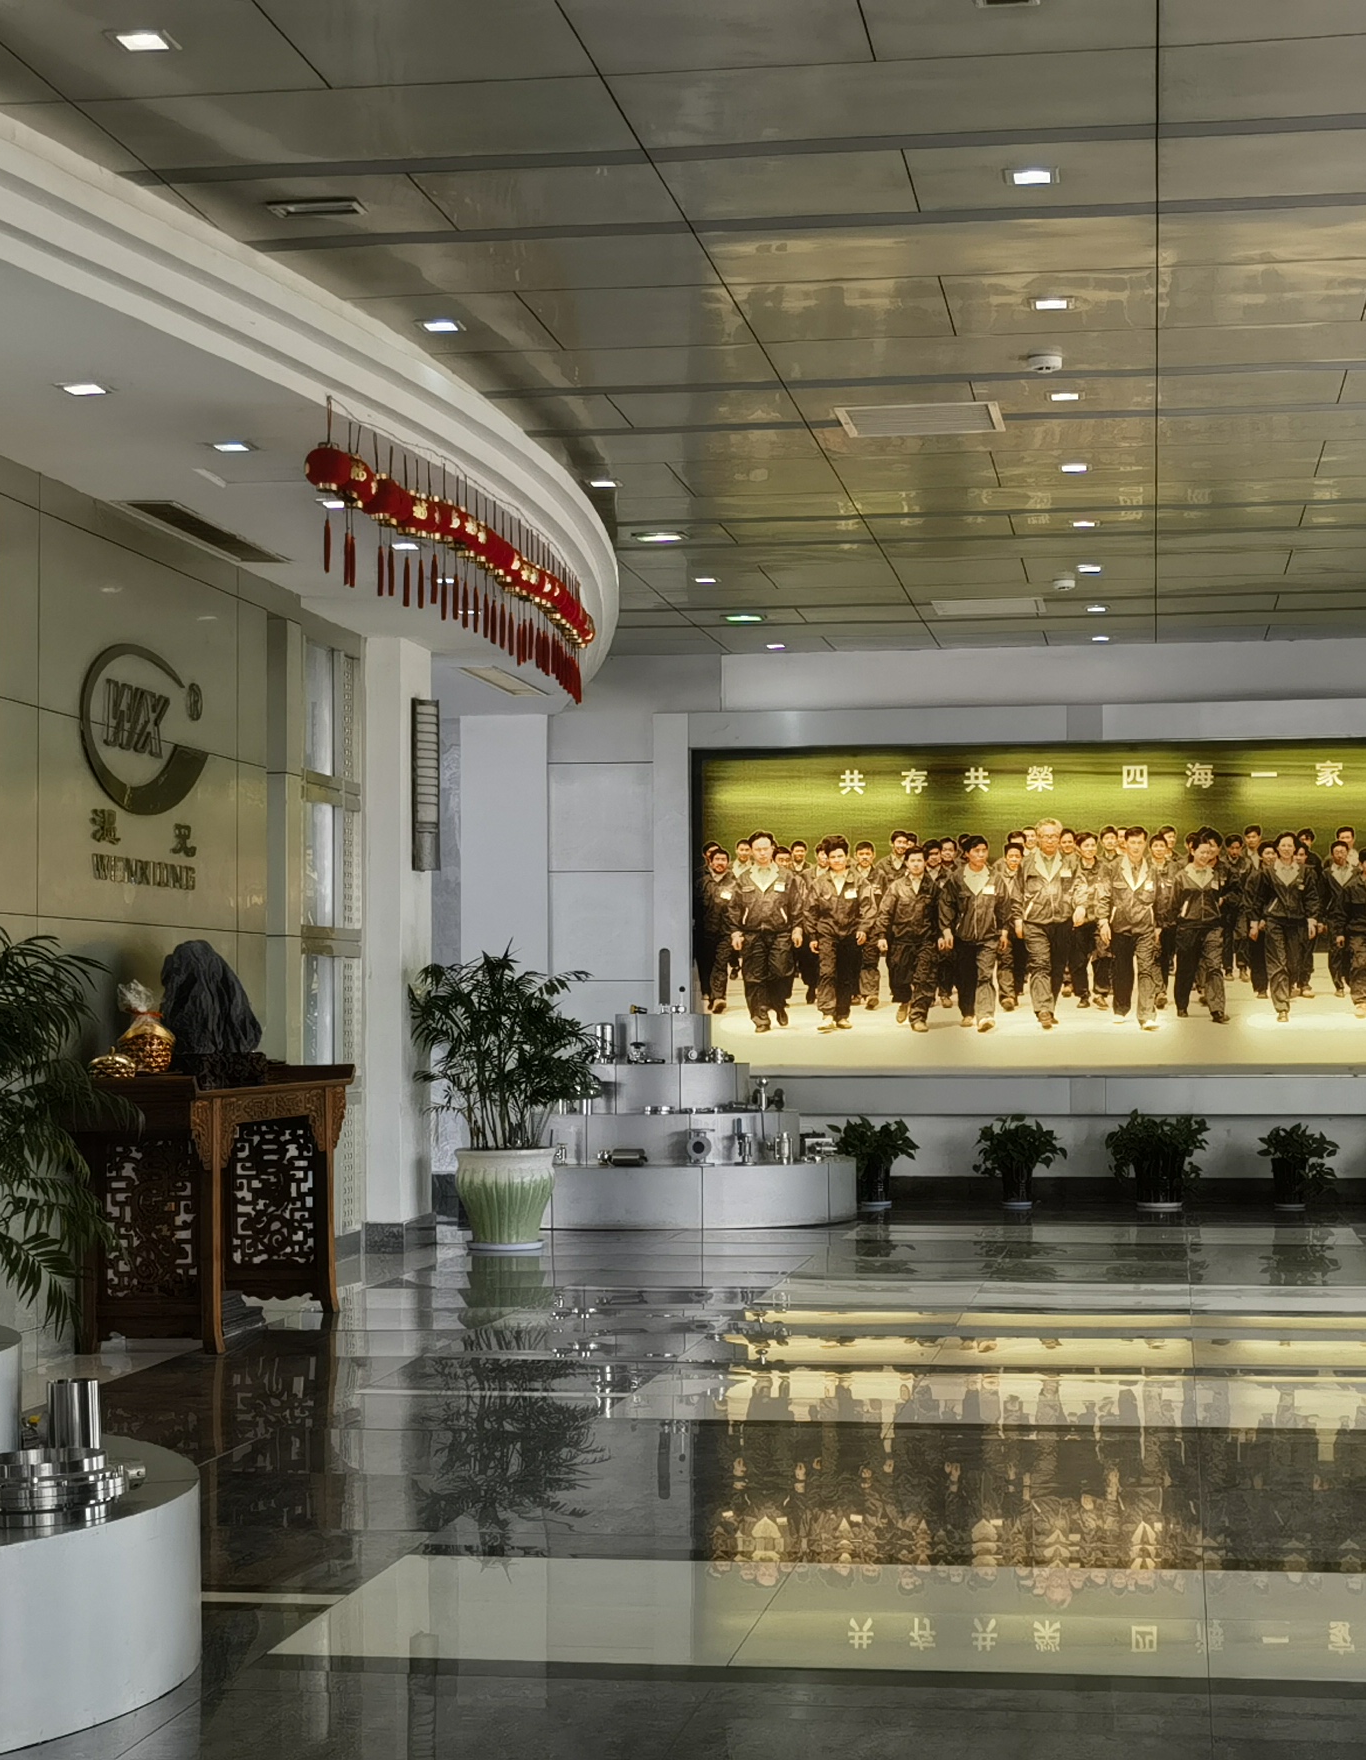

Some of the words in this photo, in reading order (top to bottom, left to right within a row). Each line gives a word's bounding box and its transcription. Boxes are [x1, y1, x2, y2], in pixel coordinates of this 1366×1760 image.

[103, 678, 171, 759] WX
[838, 764, 1055, 796] 共存共榮
[1121, 760, 1345, 791] 四海一家
